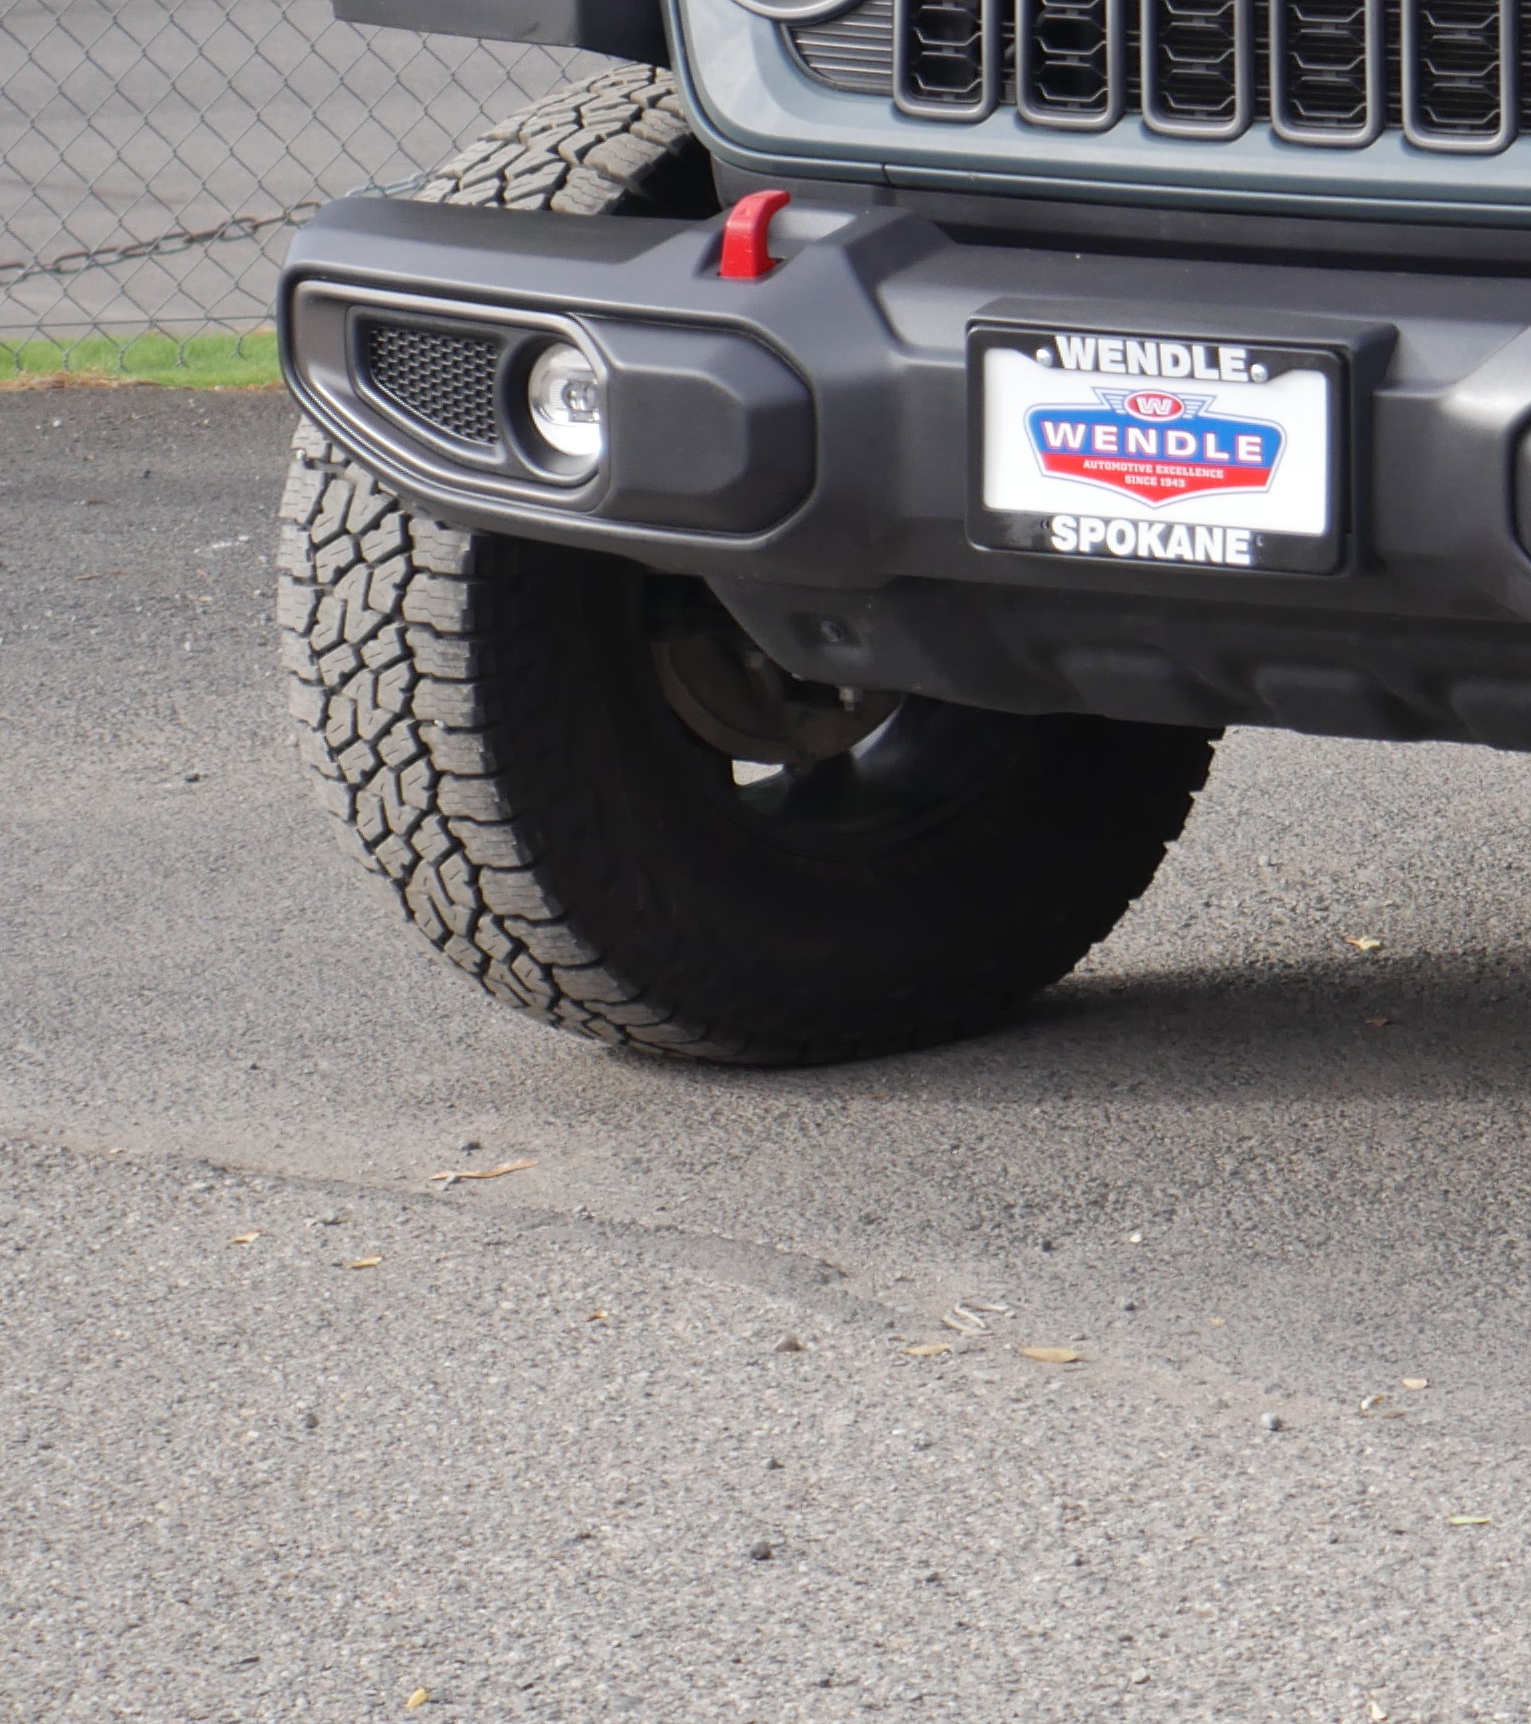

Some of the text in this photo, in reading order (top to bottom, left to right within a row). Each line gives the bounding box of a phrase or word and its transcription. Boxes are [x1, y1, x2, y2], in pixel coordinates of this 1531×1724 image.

[1055, 334, 1249, 382] WENDLE
[1136, 396, 1173, 416] W
[1043, 421, 1262, 462] WENDLE
[1083, 460, 1224, 479] AUTOMOTIVE EXCELLENCE
[1125, 475, 1157, 486] SINCE
[1051, 515, 1250, 565] SPOKANE
